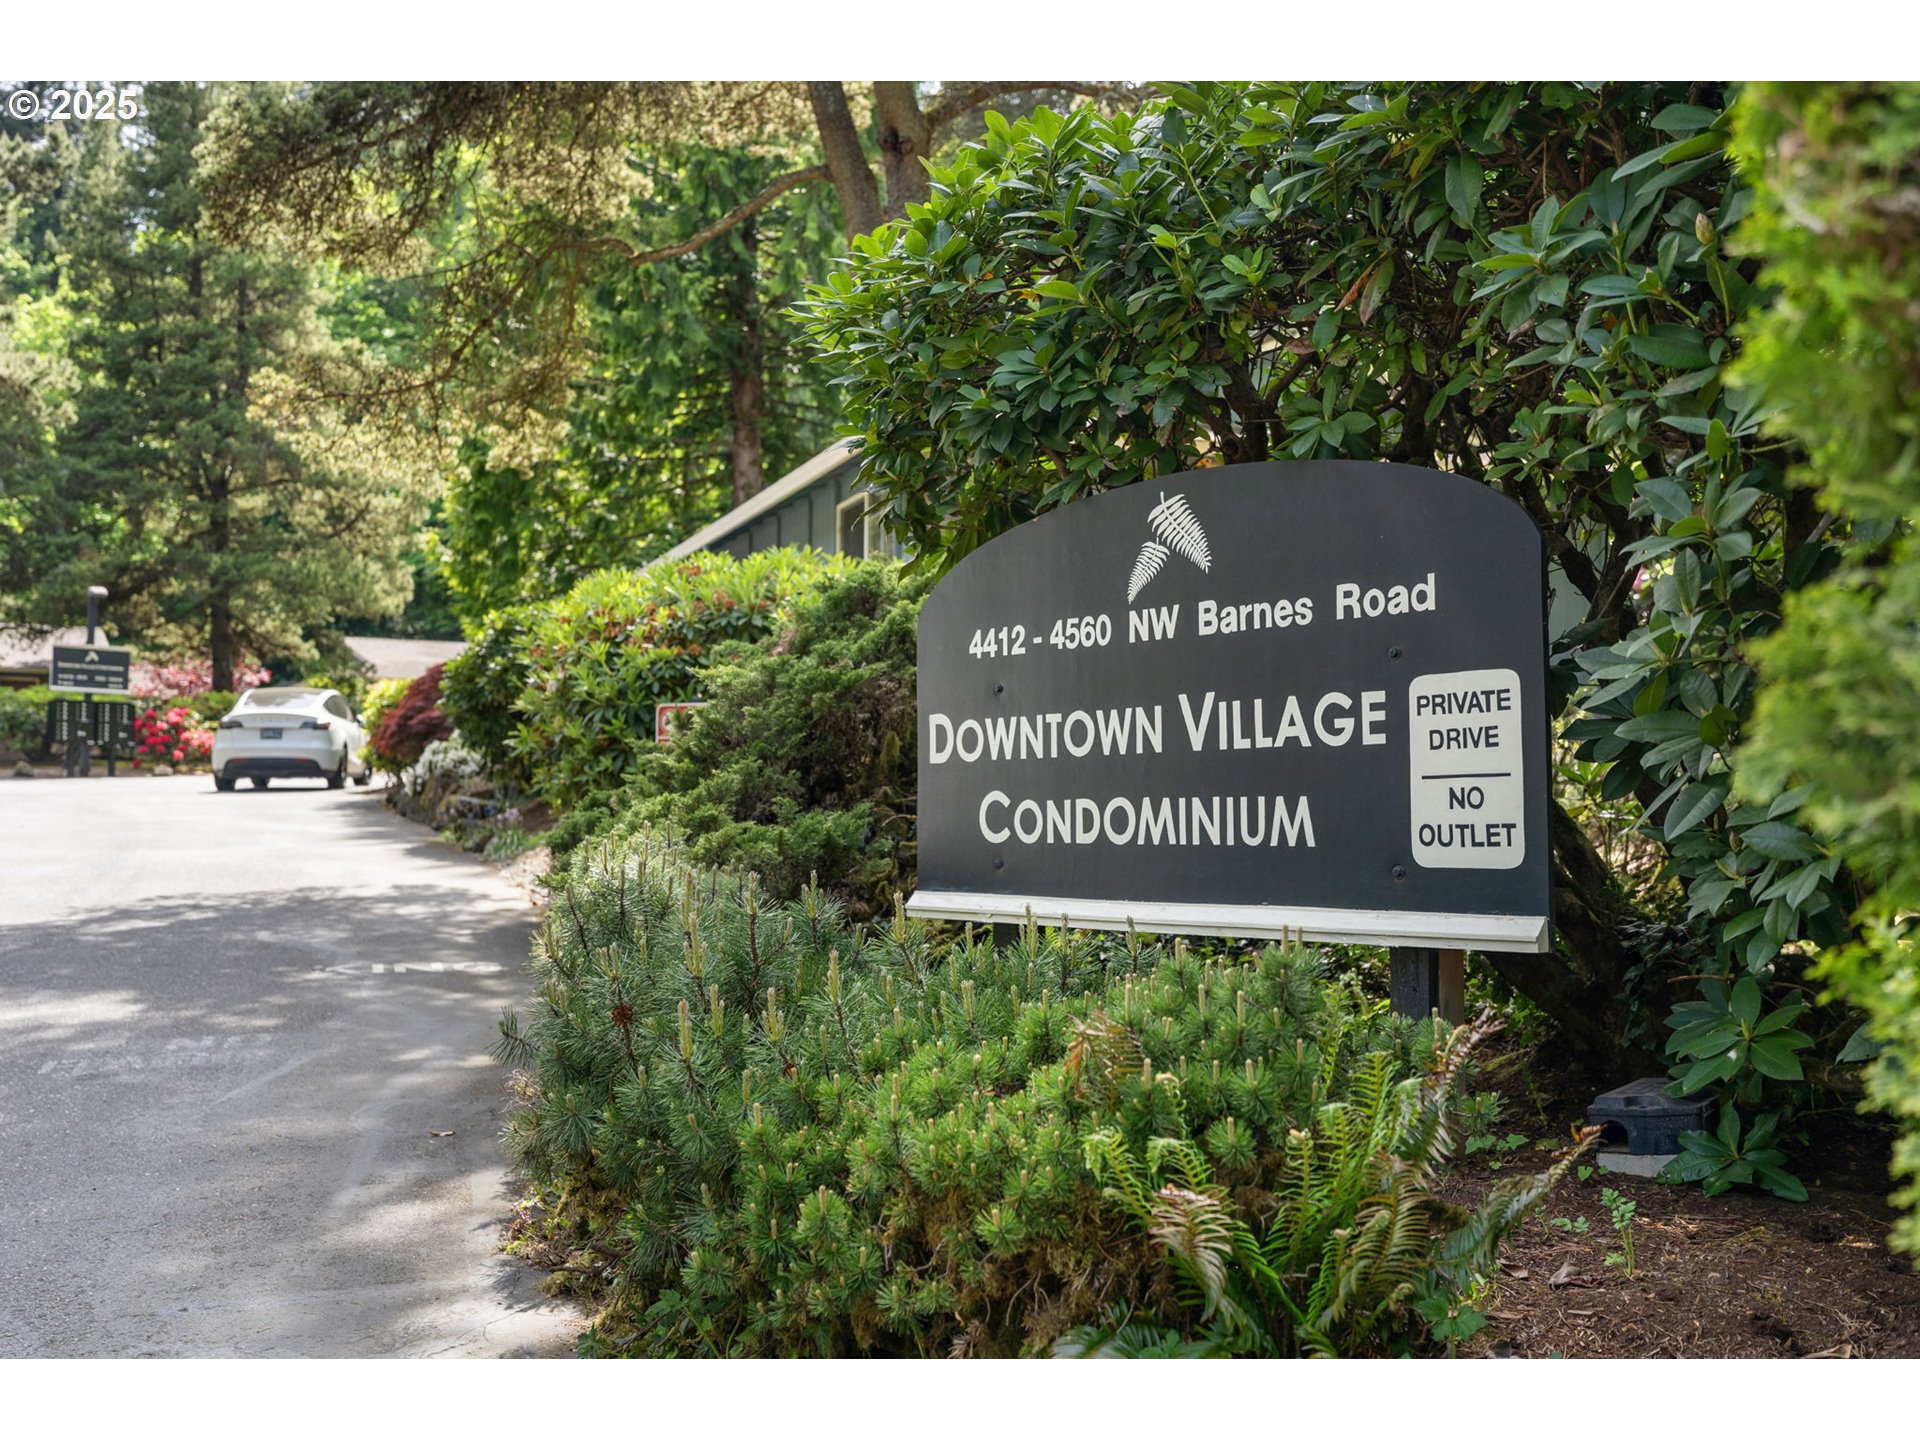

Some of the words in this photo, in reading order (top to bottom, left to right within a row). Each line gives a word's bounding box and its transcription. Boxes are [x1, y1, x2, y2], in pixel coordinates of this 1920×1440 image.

[968, 624, 1027, 660] 4412
[1049, 613, 1112, 650] 4560
[1128, 603, 1180, 644] NW
[1198, 597, 1314, 636] Barnes
[1335, 572, 1436, 621] Road
[1416, 688, 1512, 717] PRIVATE
[928, 704, 1163, 765] DOWNTOWN
[1177, 690, 1387, 752] VILLAGE
[1429, 725, 1500, 751] DRIVE
[1448, 786, 1485, 810] NO
[978, 789, 1316, 848] CONDOMINIUM
[1418, 823, 1517, 848] OUTLET
